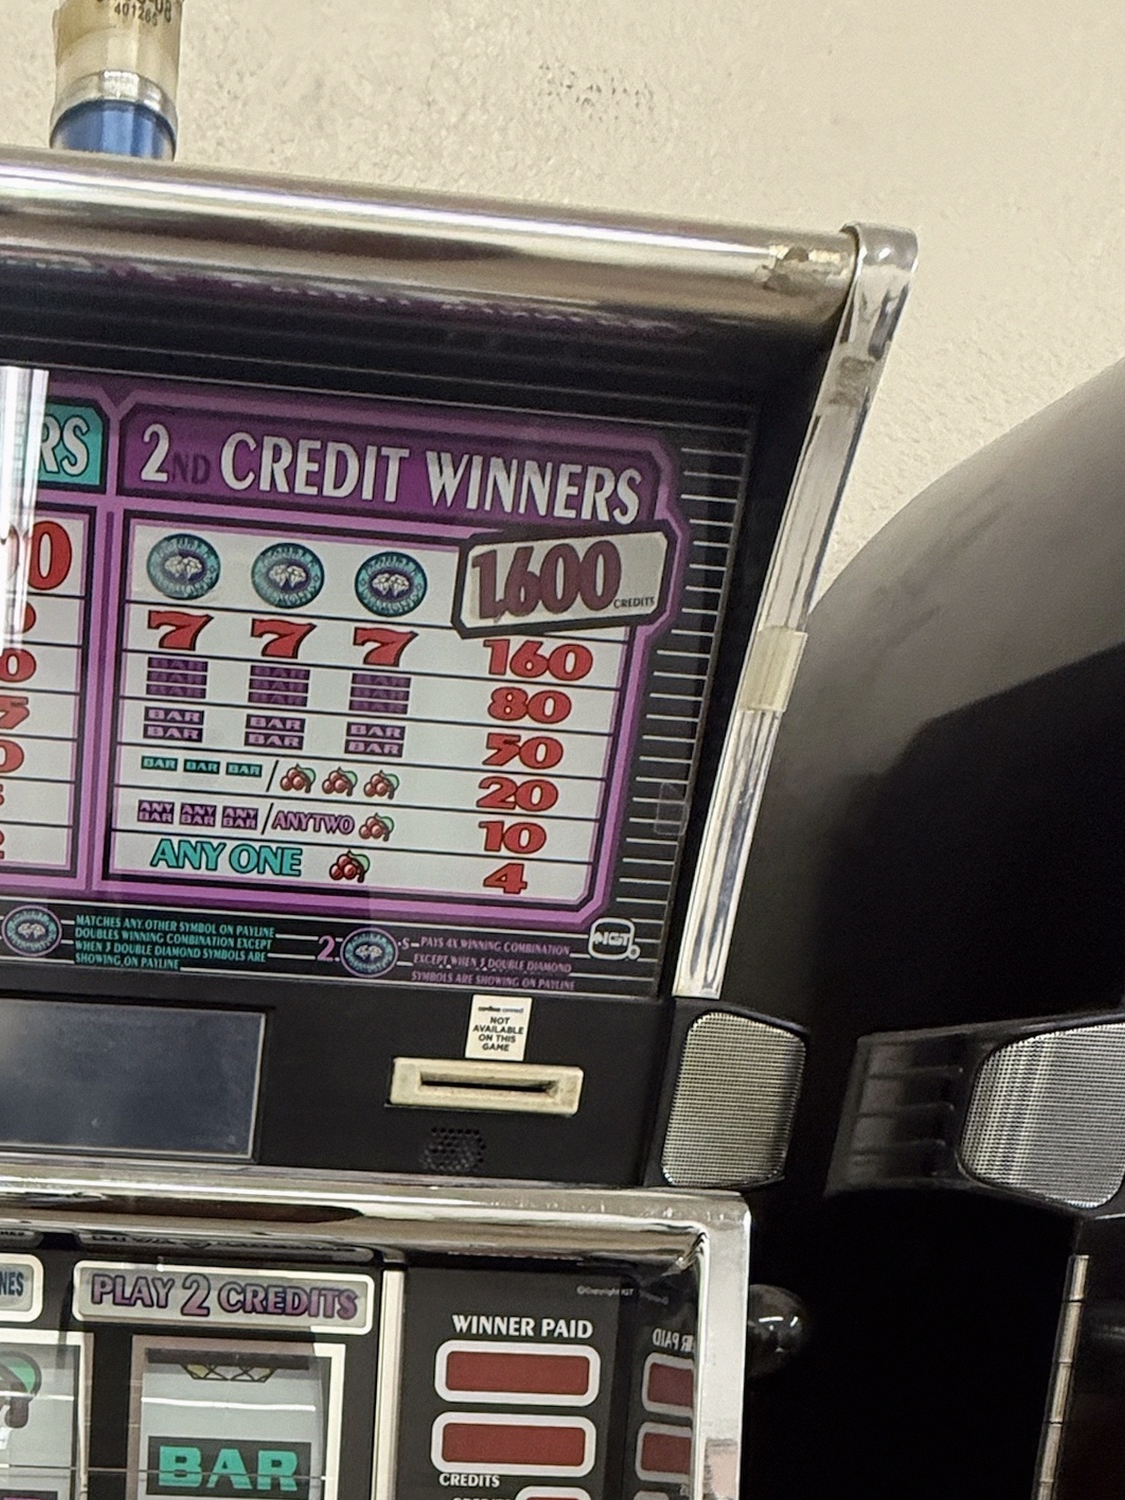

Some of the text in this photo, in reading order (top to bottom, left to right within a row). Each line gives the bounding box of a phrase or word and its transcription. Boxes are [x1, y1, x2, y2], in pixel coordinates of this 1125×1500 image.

[220, 431, 411, 503] CREDIT
[425, 450, 642, 525] WINNERS
[613, 597, 655, 609] CREDITS
[147, 610, 593, 682] 7 7 7 160
[488, 686, 572, 724] 80
[482, 732, 563, 769] 50
[476, 776, 559, 812] 20
[478, 820, 547, 855] 10
[150, 838, 528, 895] ANY ONE 4
[76, 914, 275, 938] MATCHES ANY OTHER SYMBOL ON PAYLINE
[75, 927, 273, 950] DOUBLES WINNING COMBINATION EXCEPT
[75, 940, 103, 952] WHEN
[113, 943, 153, 956] DOUBLE
[154, 945, 201, 959] DIAMOND
[202, 948, 246, 961] SYMBOLS
[247, 951, 267, 963] ARE
[75, 952, 180, 971] SHOWING ON PAYLINE
[472, 1024, 524, 1035] AVAILABLE
[490, 1016, 510, 1025] NOT
[478, 1033, 516, 1043] ON THIS
[482, 1042, 510, 1051] GAME
[91, 1272, 358, 1320] PLAY 2 CREDITS
[452, 1314, 593, 1339] WINNER PAID
[159, 1445, 298, 1492] BAR
[439, 1473, 500, 1488] CREDITS
